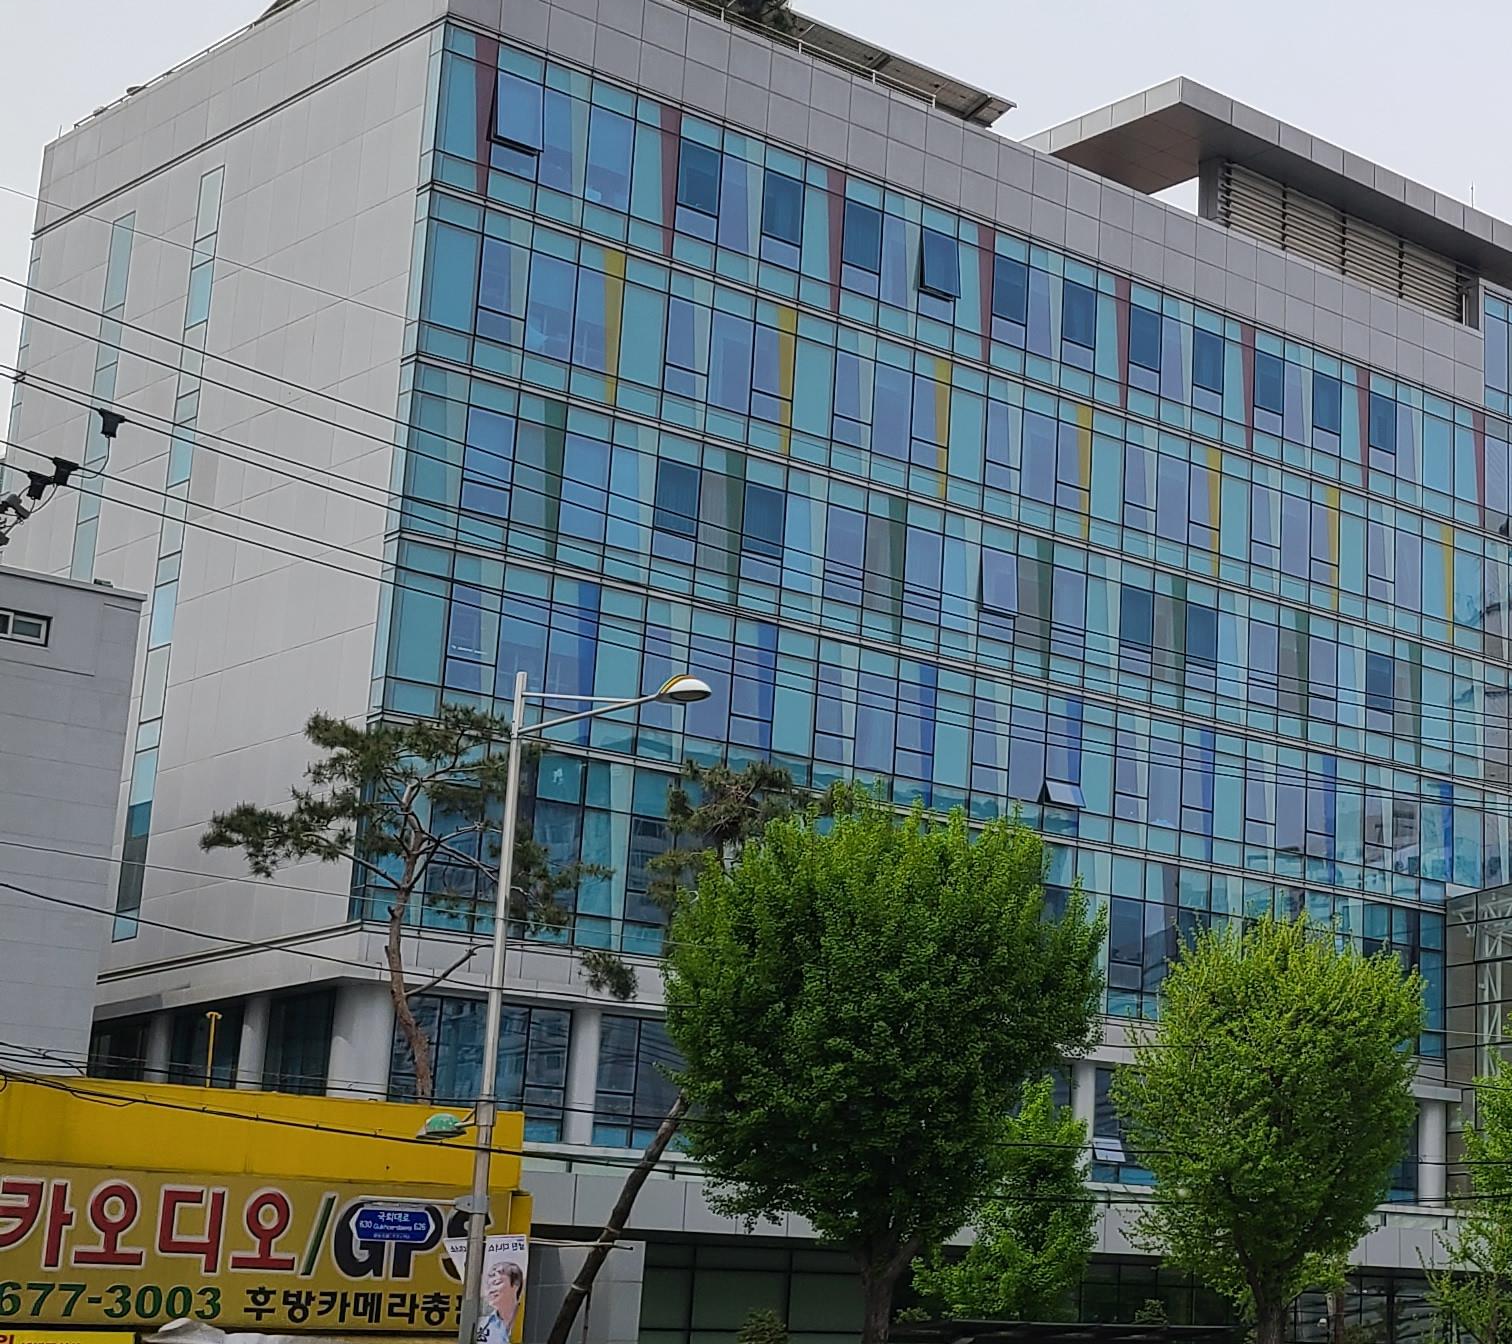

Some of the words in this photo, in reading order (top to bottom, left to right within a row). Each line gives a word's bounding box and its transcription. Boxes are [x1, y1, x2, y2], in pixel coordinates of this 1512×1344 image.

[377, 1211, 411, 1223] 국회대로
[0, 1280, 222, 1320] 677-3003
[243, 1286, 463, 1327] 후방카메라총
